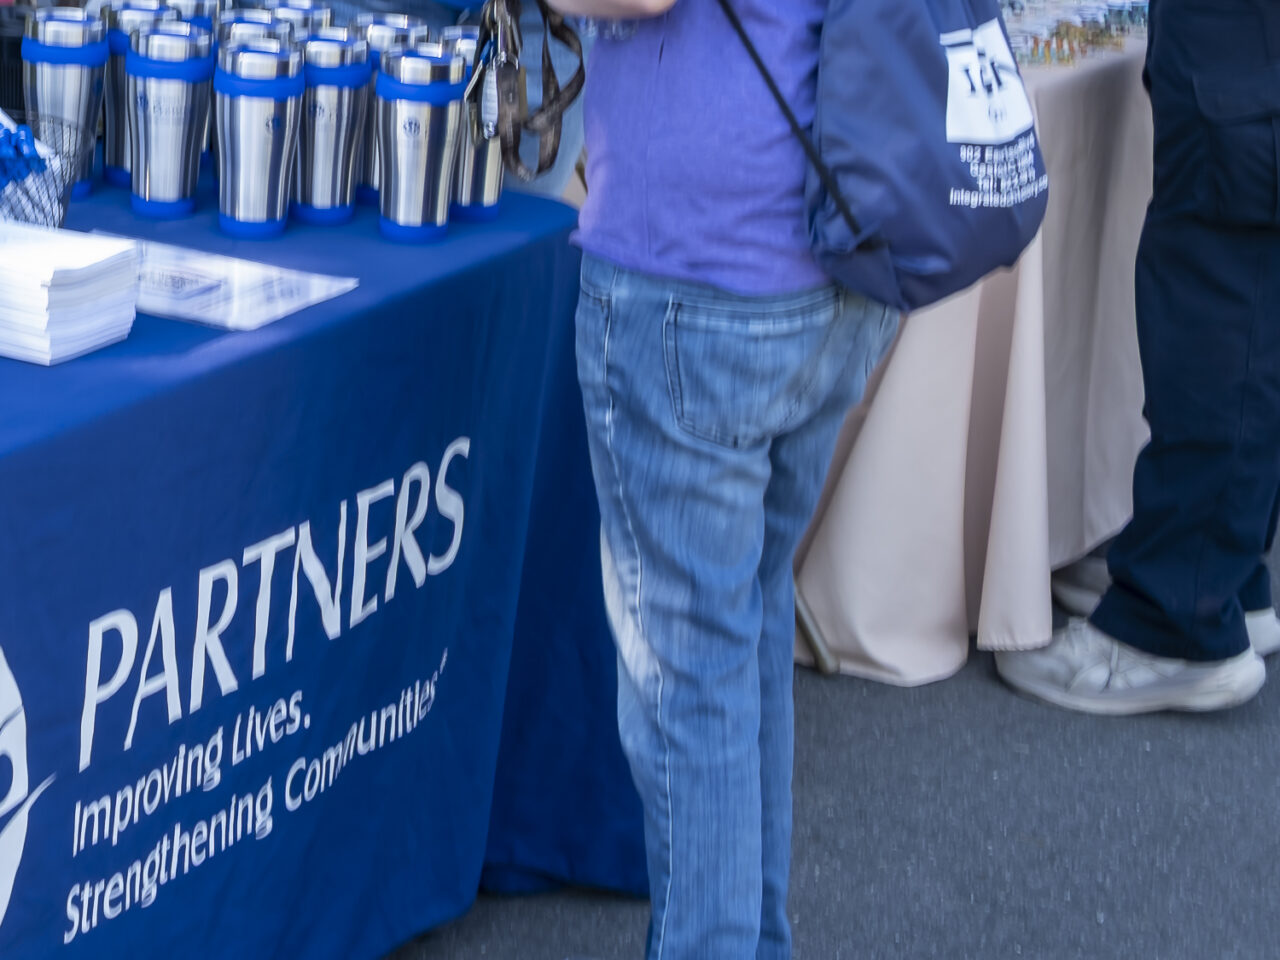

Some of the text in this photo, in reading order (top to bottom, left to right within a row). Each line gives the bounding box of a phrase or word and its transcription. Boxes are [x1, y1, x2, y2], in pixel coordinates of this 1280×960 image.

[79, 436, 470, 773] PARTNERS
[73, 690, 311, 858] Improving Lives.
[63, 775, 273, 944] Strengthening
